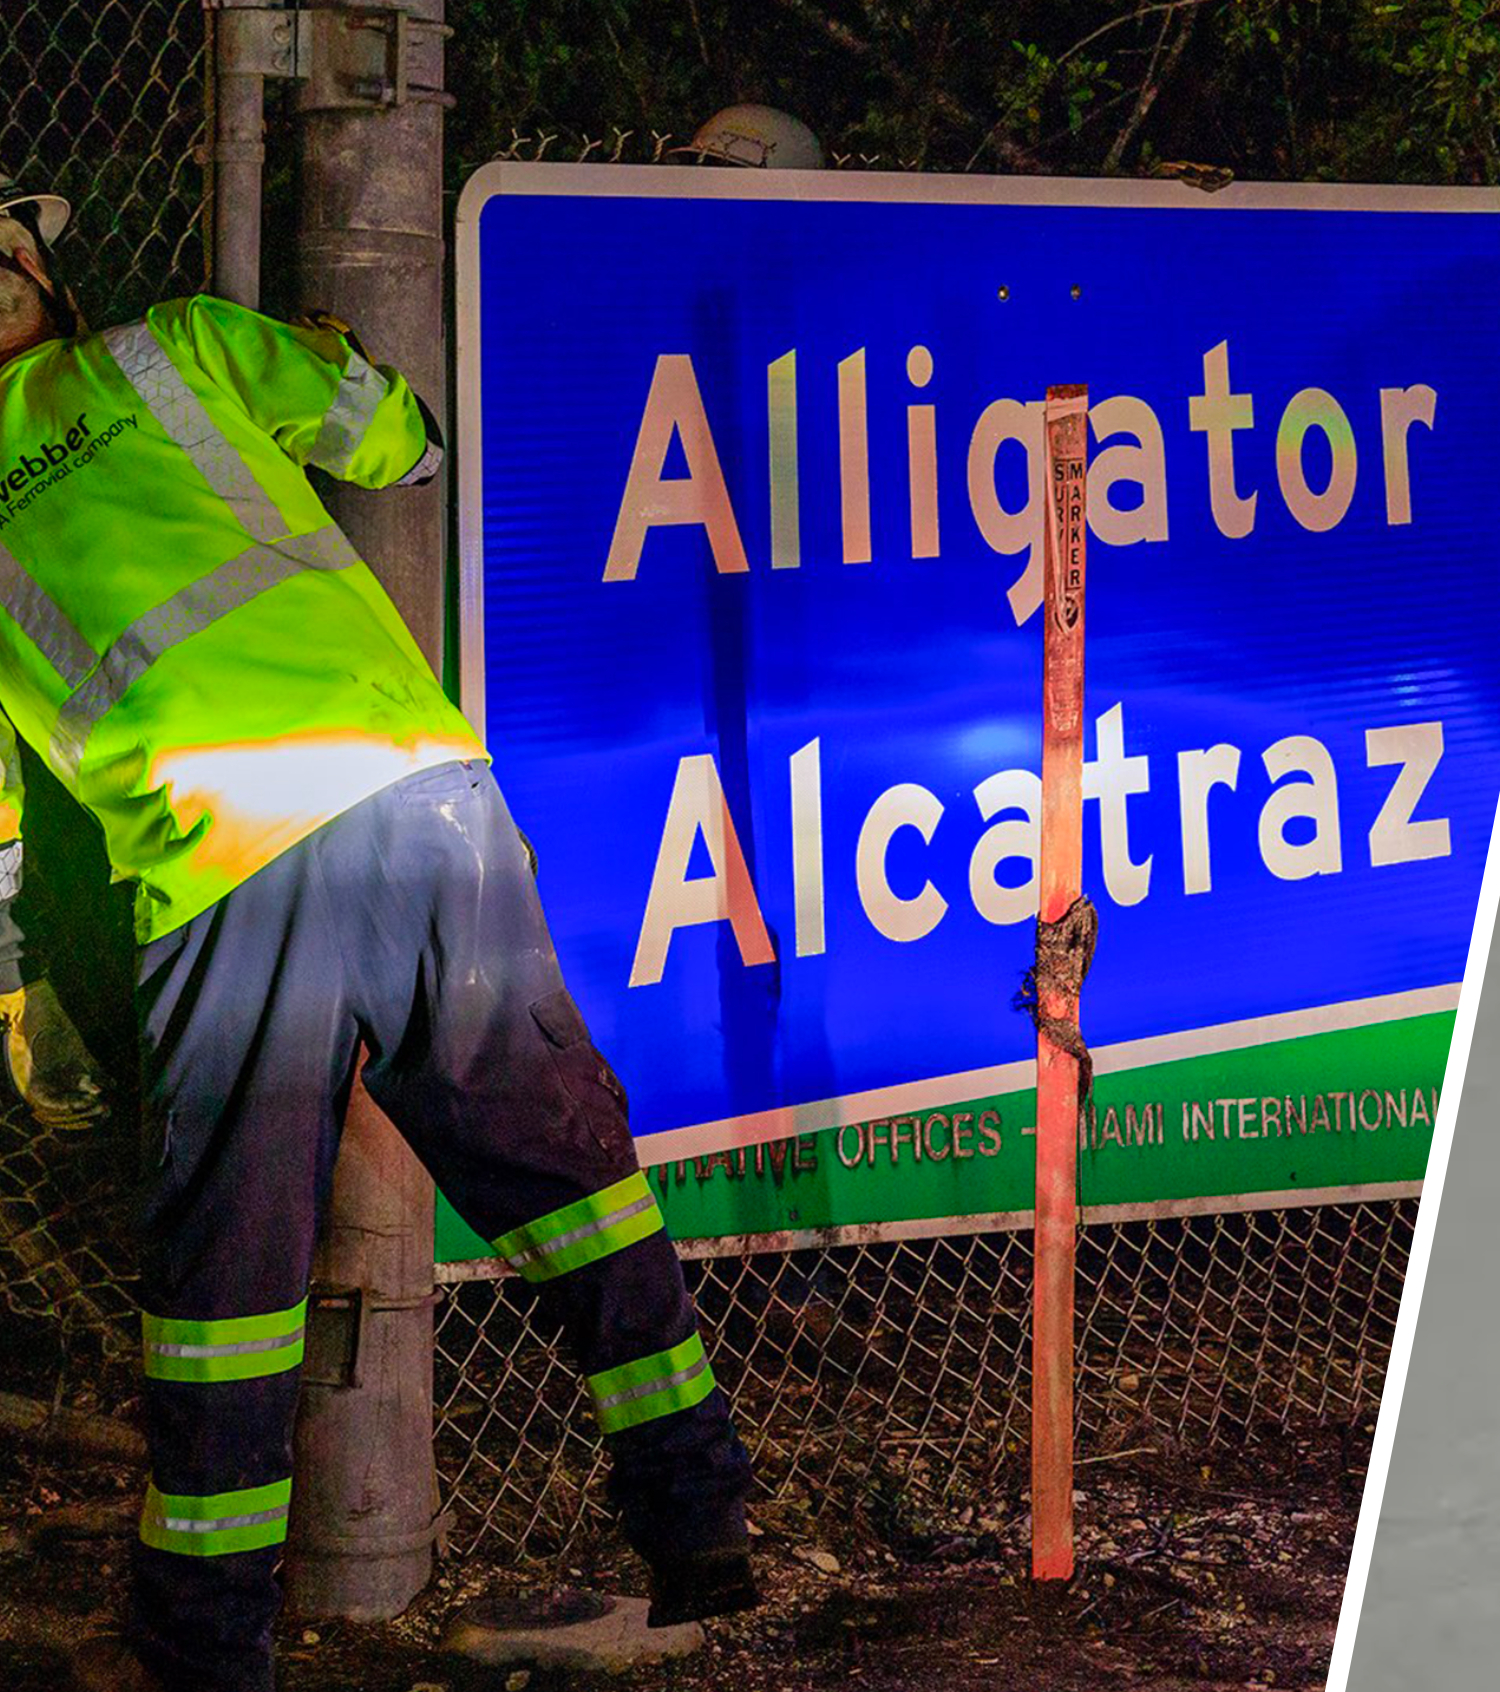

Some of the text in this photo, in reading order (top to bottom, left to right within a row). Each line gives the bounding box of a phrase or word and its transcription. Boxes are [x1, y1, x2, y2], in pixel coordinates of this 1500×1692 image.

[6, 463, 73, 518] Ferrovial
[72, 414, 138, 469] company
[601, 340, 1438, 627] Alligator
[1069, 463, 1083, 586] MARKER
[628, 702, 1452, 988] Alcatraz
[837, 1110, 1002, 1169] OFFICES
